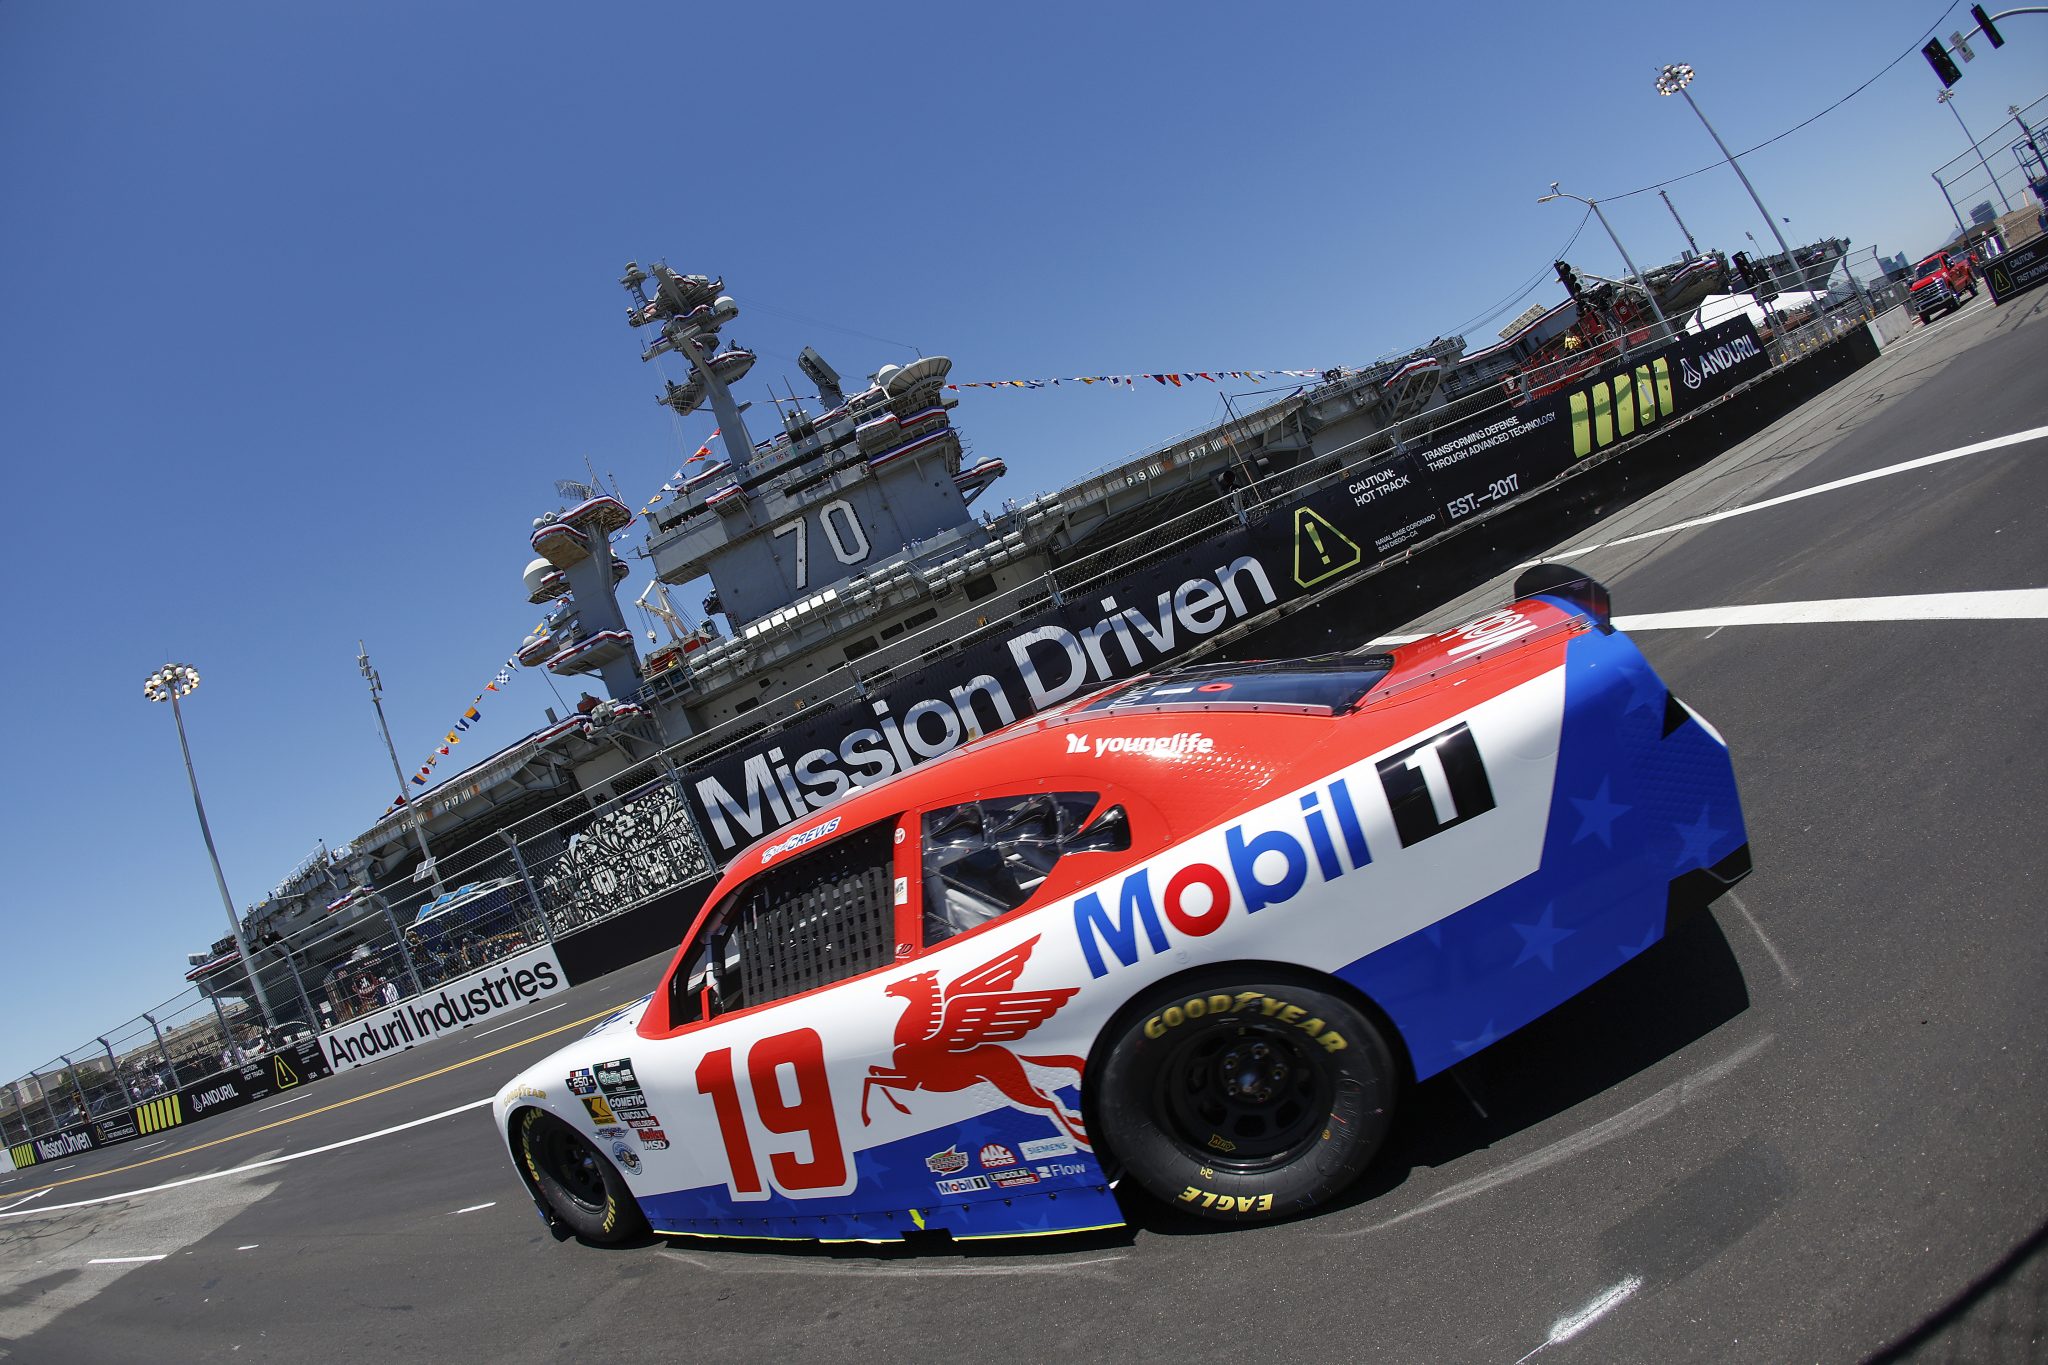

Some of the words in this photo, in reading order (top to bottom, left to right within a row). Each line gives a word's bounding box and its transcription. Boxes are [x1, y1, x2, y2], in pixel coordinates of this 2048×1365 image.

[2016, 271, 2030, 285] FAST
[1700, 334, 1761, 378] ANDURIL
[1422, 430, 1486, 461] TRANSFORMING
[1485, 416, 1520, 436] DEFENSE
[1427, 450, 1469, 472] THROUGH
[1469, 433, 1510, 457] ADVANCED
[1508, 412, 1556, 440] TECHNOLOGY
[1349, 469, 1396, 495] CAUTION:
[1354, 491, 1376, 507] HOT
[1377, 475, 1411, 497] TRACK
[1375, 534, 1393, 546] NAVAL
[1391, 528, 1406, 540] BASE
[1405, 513, 1436, 532] CORONADO
[773, 499, 872, 590] 70
[1378, 543, 1390, 553] SAN
[695, 674, 1016, 850] Mission
[1007, 555, 1277, 710] Driven
[787, 817, 840, 850] CREWS
[1073, 778, 1374, 980] Mobil
[1404, 743, 1459, 826] 1
[328, 1011, 415, 1068] Anduril
[407, 961, 558, 1037] Industries
[1144, 991, 1348, 1053] GOODYEAR
[244, 1073, 253, 1081] HOT
[251, 1068, 265, 1078] TRACK
[573, 1077, 588, 1088] 250
[201, 1083, 239, 1107] ANDURIL
[504, 1084, 547, 1107] GOODYEAR
[609, 1095, 644, 1108] COMETIC
[619, 1110, 650, 1120] LINCOLN
[694, 1027, 847, 1193] 19
[629, 1120, 656, 1128] WELDERS
[638, 1128, 666, 1141] Holley
[36, 1134, 66, 1160] Mission
[62, 1131, 92, 1154] Driven
[644, 1140, 667, 1151] MSD
[981, 1144, 1014, 1160] MAC
[1027, 1142, 1068, 1155] SIEMENS
[984, 1158, 1016, 1168] TOOLS
[990, 1168, 1028, 1181] LINCOLN
[1049, 1163, 1086, 1177] Flow
[939, 1179, 974, 1193] Mobil
[1178, 1186, 1274, 1212] EAGLE
[603, 1195, 616, 1233] EAGLE
